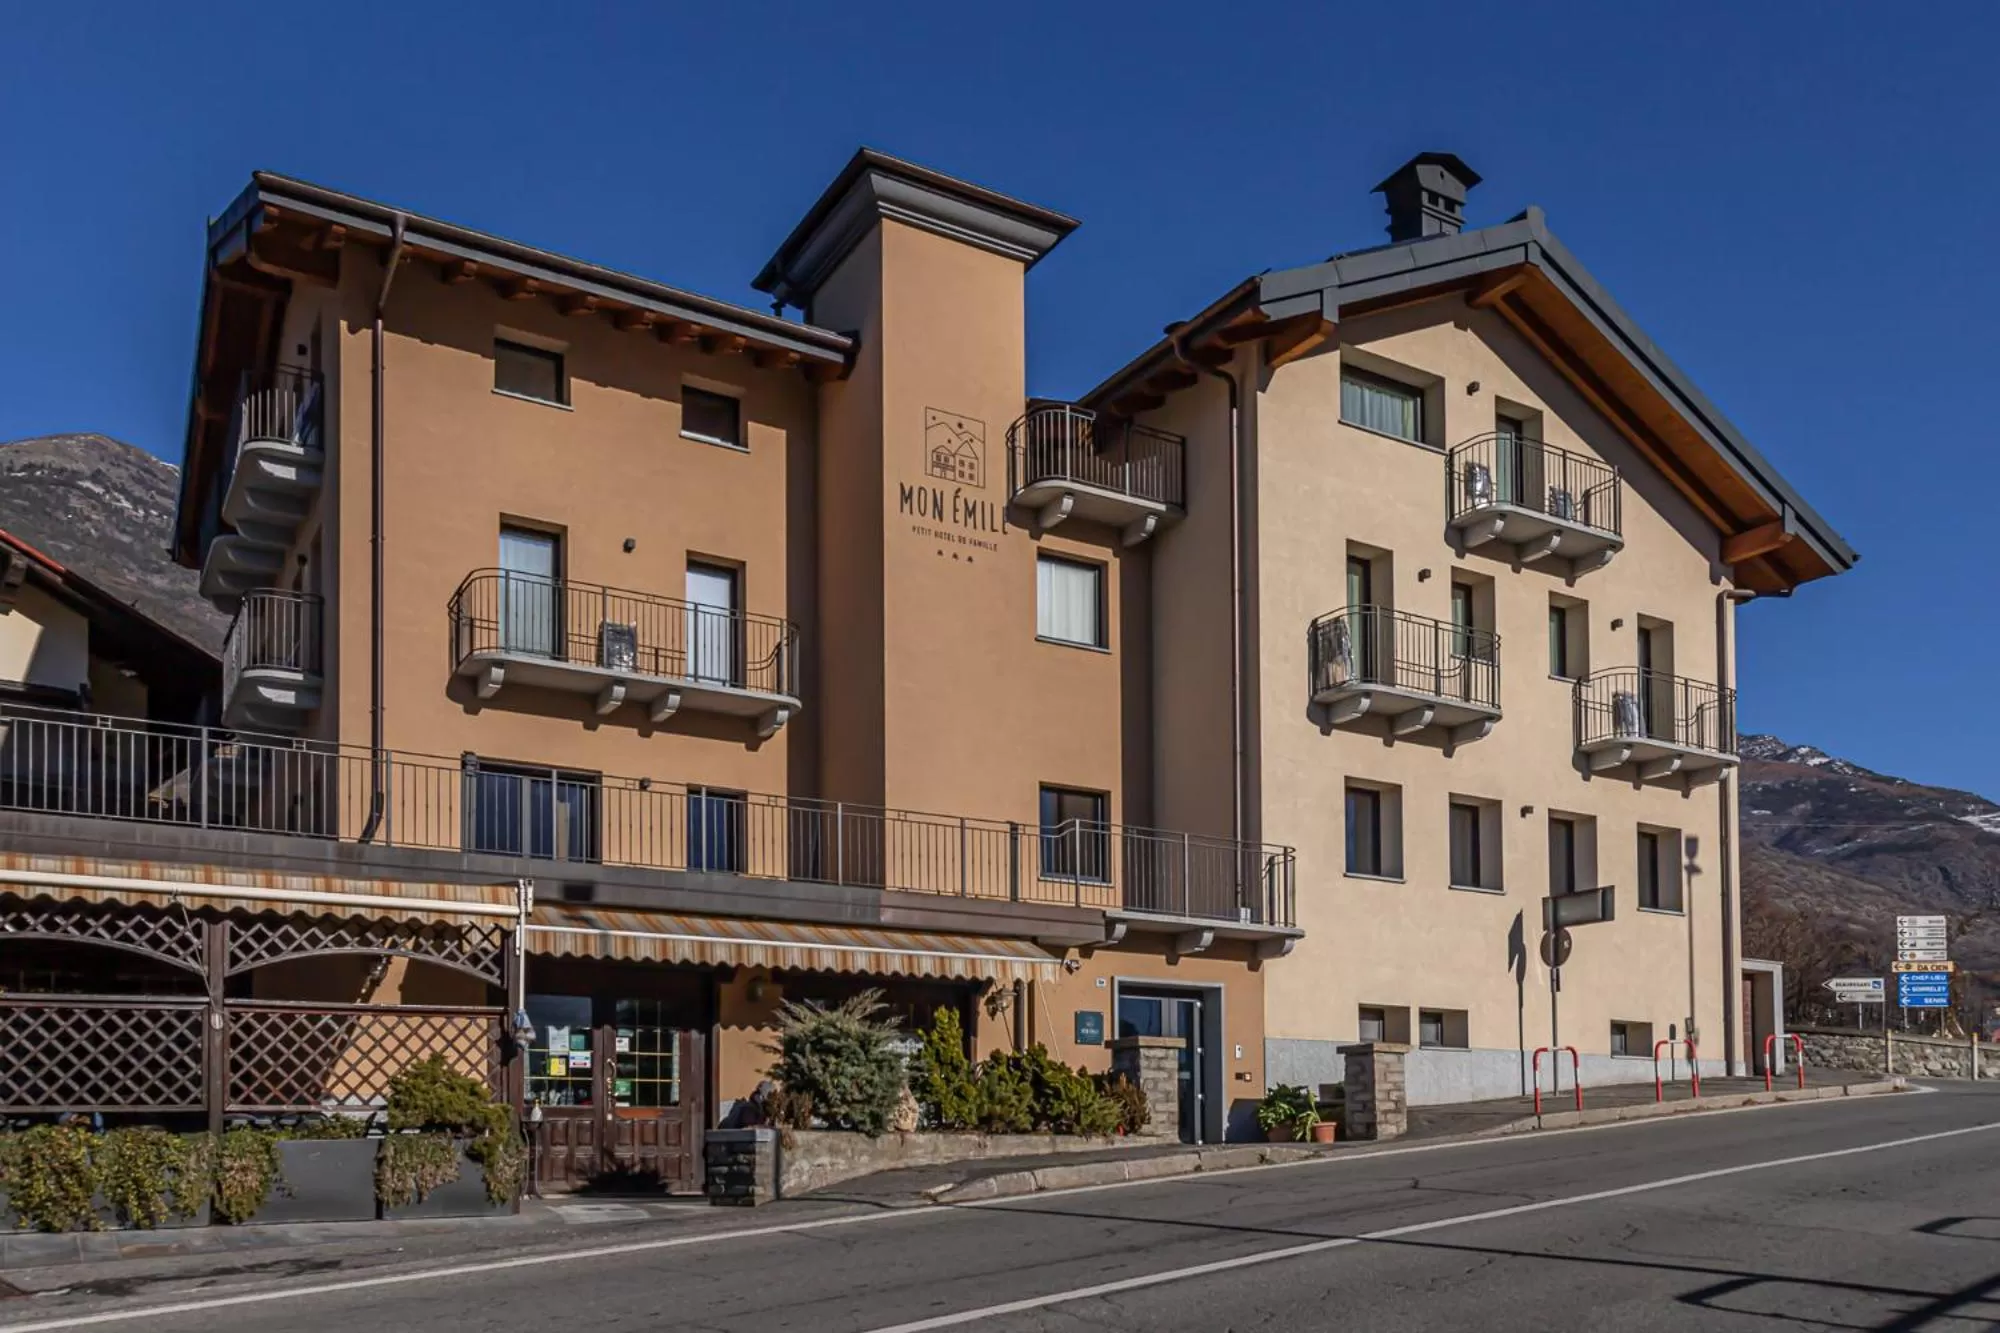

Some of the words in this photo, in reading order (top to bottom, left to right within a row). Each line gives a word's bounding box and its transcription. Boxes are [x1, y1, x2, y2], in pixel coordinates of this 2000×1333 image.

[899, 481, 944, 523] MON
[911, 525, 932, 537] PETIT
[968, 538, 998, 552] FAMILLE
